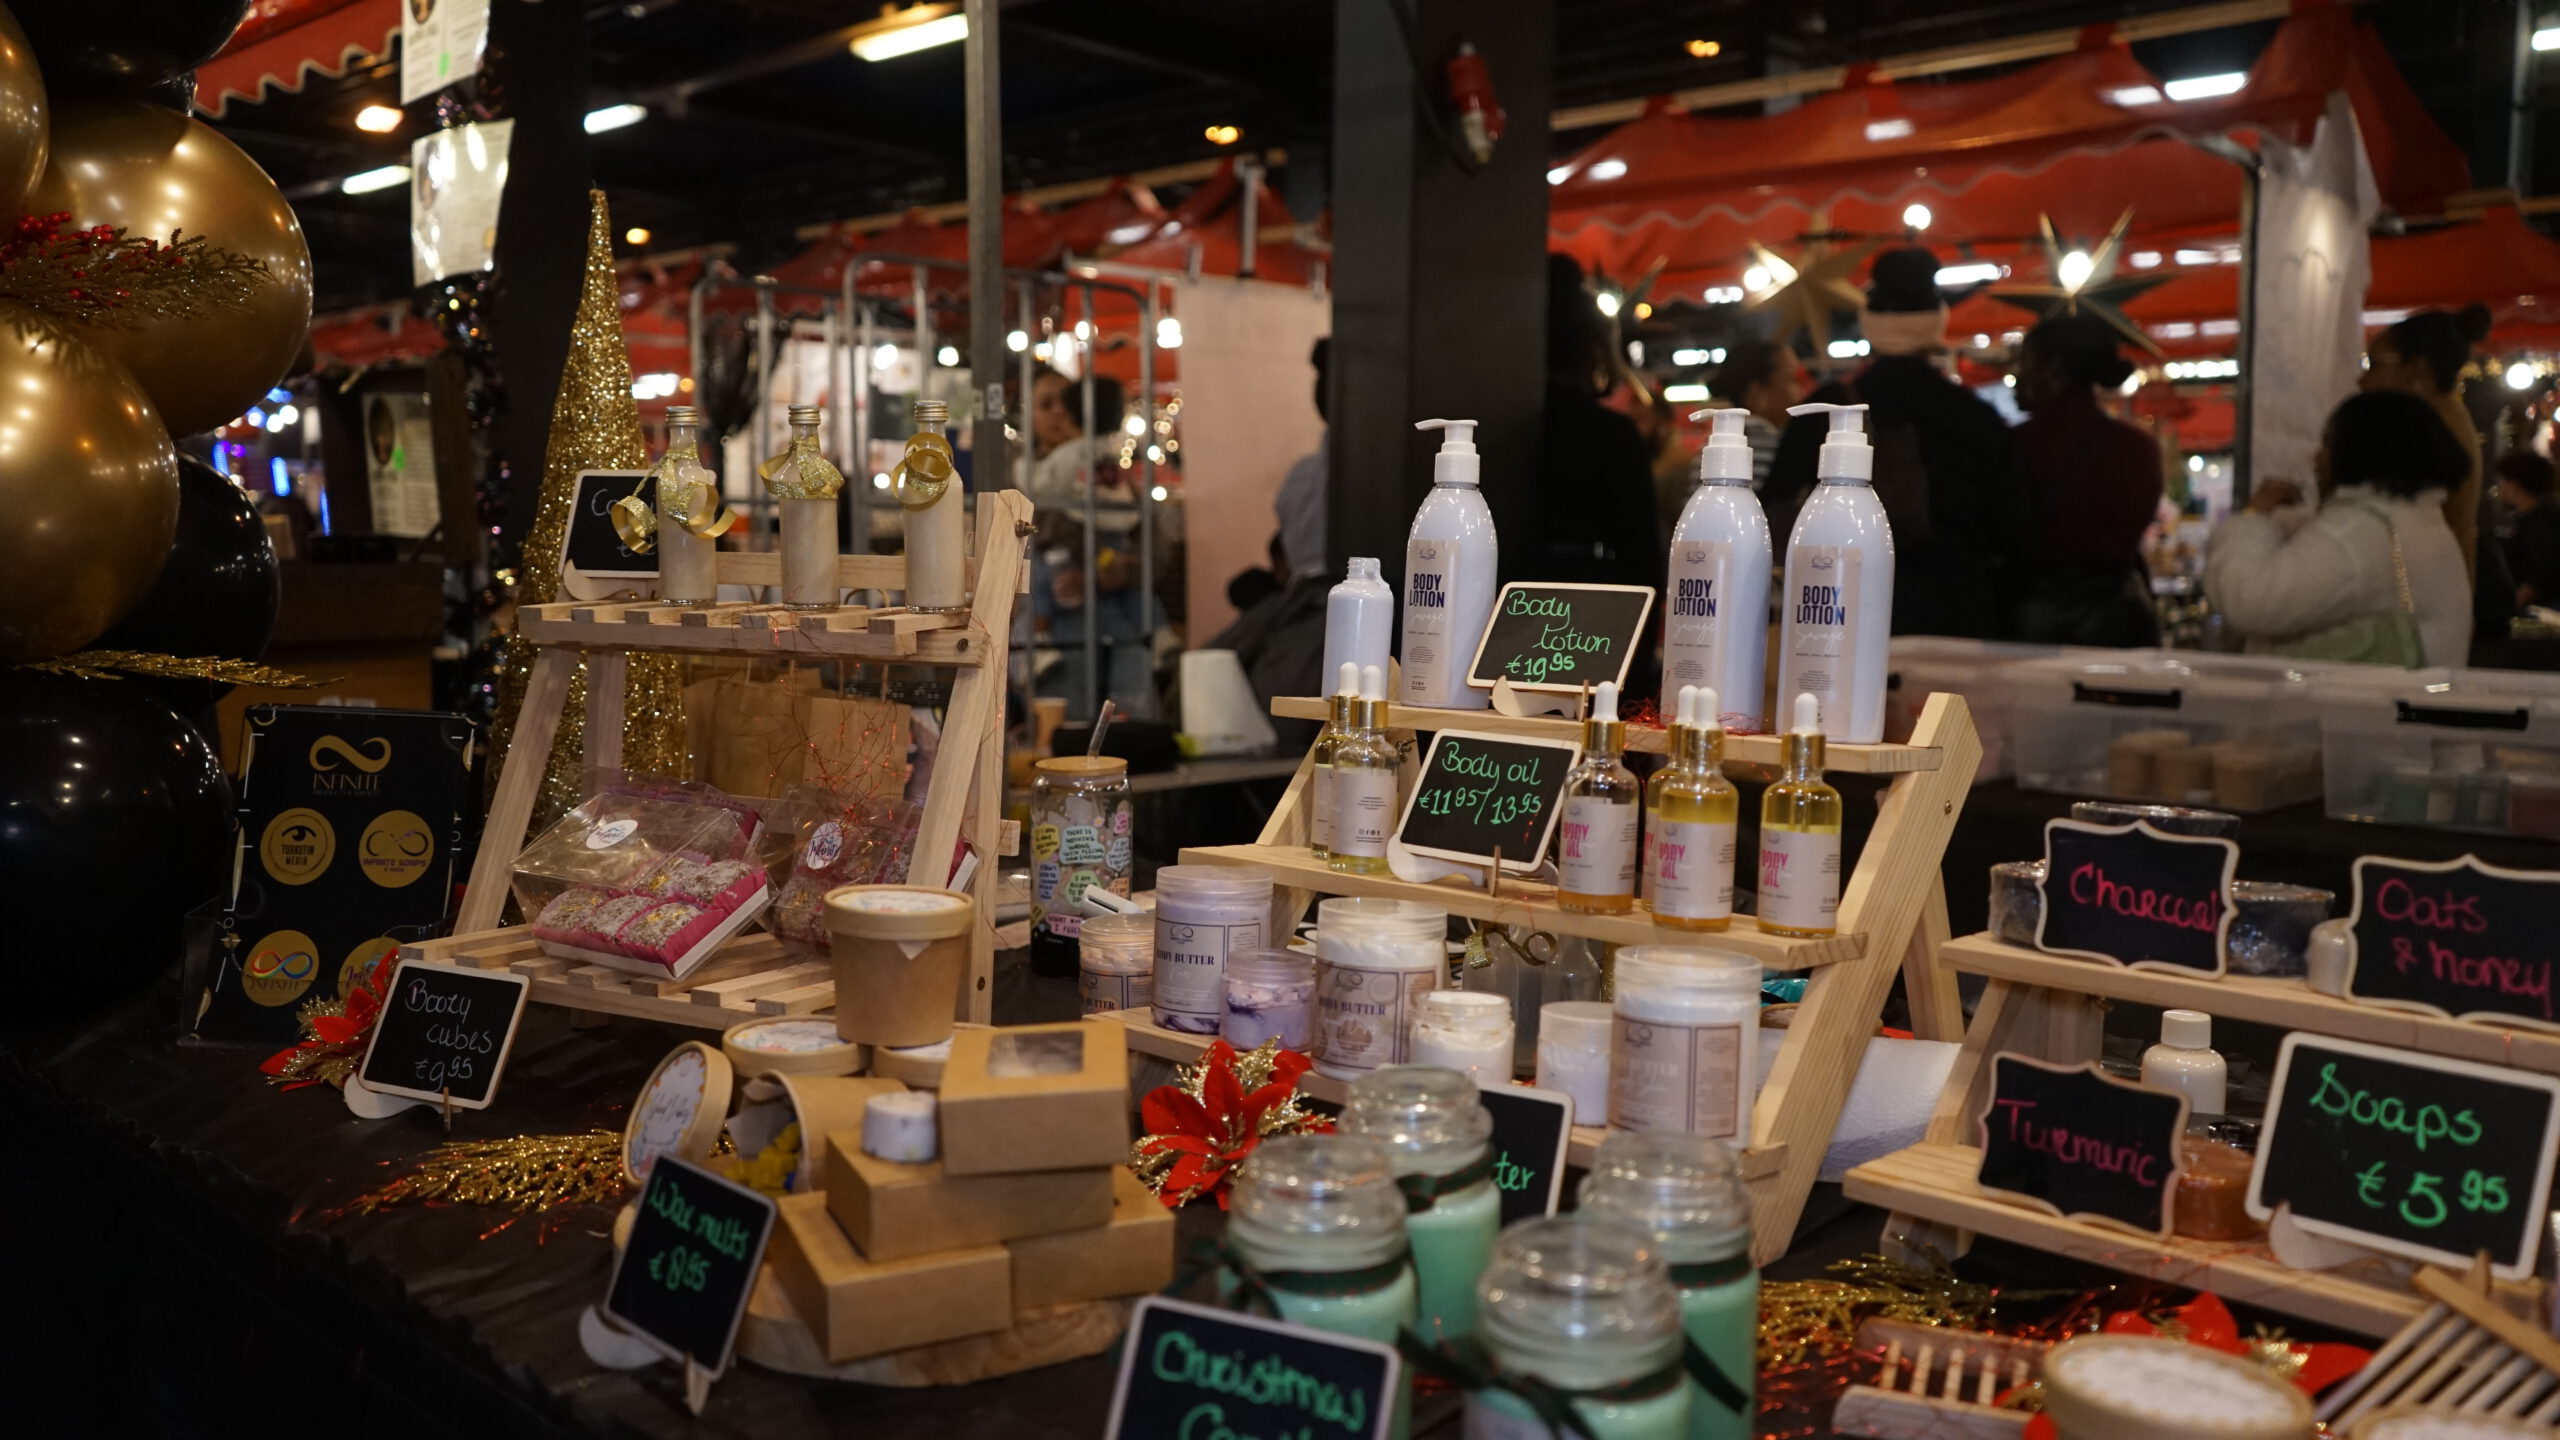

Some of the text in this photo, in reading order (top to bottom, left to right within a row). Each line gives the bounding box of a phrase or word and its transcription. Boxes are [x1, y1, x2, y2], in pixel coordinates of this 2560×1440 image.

[1413, 573, 1442, 591] BODY
[1679, 579, 1712, 598] BODY
[1409, 590, 1445, 608] LOTION
[1802, 585, 1841, 606] BODY
[1507, 590, 1571, 631] Body
[1674, 598, 1716, 617] LOTION
[1796, 605, 1845, 625] LOTION
[1442, 741, 1541, 791] Body oil
[313, 773, 384, 790] INFINITE
[1563, 822, 1589, 840] BODY
[1659, 842, 1686, 862] BODY
[1761, 849, 1788, 870] BODY
[2376, 878, 2488, 933] Oats
[1175, 952, 1215, 966] BUTTER
[405, 978, 471, 1024] Boozy
[1341, 1001, 1386, 1016] BUTTER
[426, 1023, 492, 1053] cubes
[2309, 1062, 2482, 1151] Soaps
[1152, 1330, 1366, 1434] Christmas
